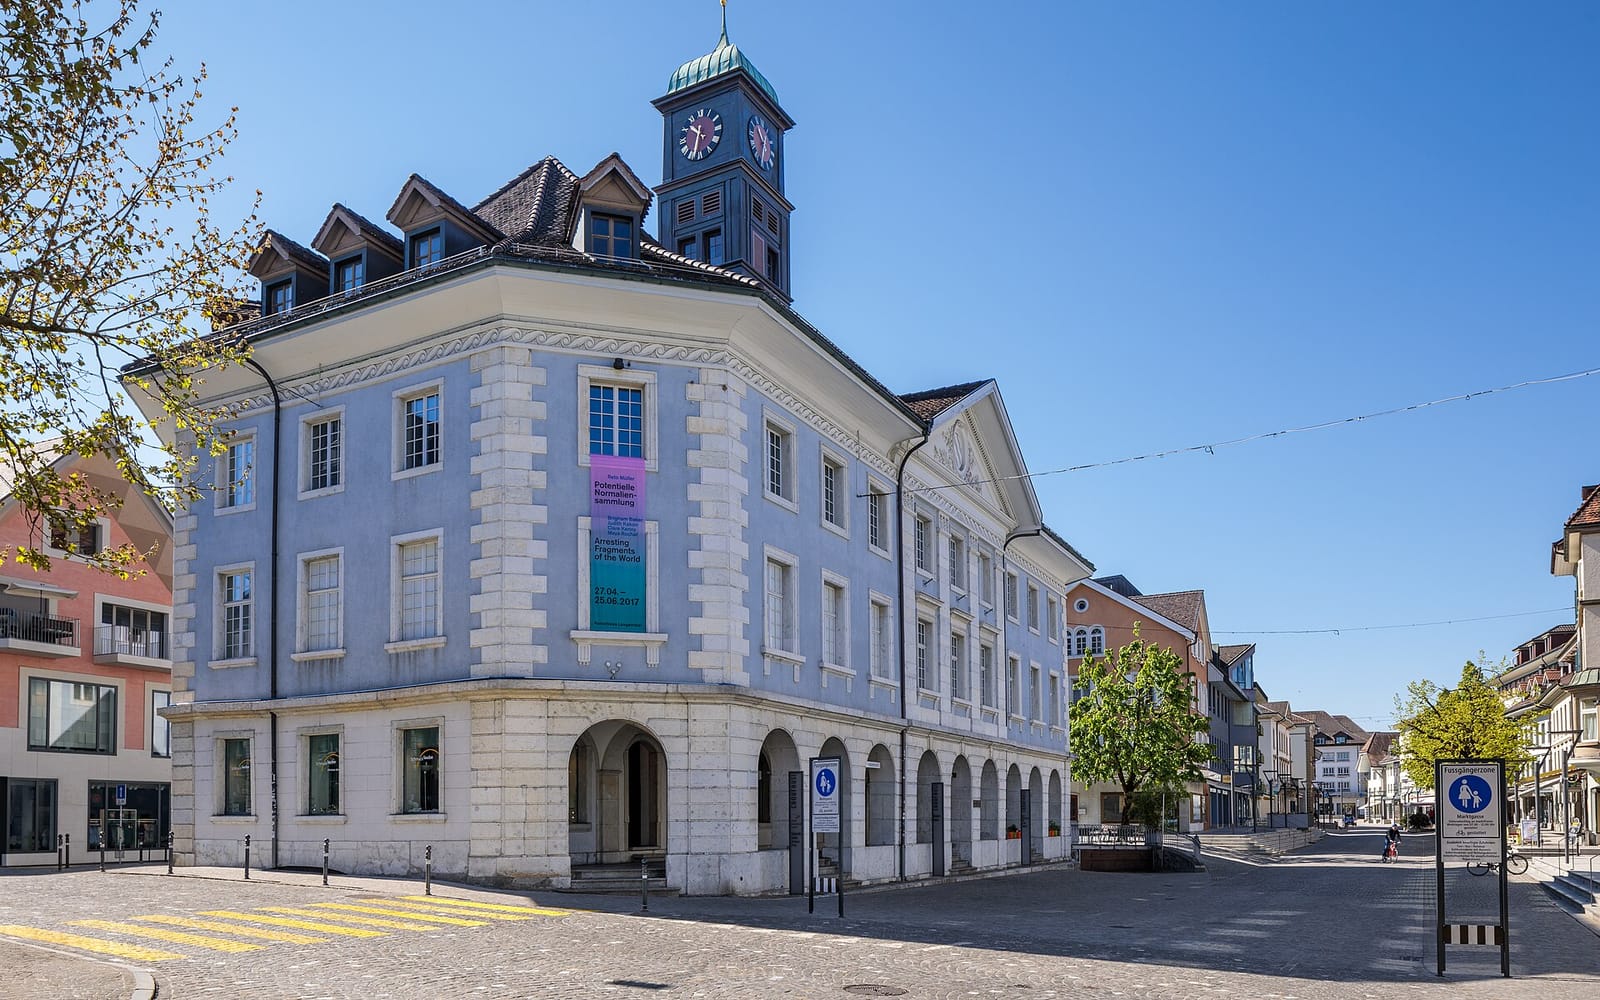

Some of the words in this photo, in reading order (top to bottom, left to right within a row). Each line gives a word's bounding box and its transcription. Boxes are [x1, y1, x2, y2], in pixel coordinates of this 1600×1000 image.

[595, 481, 635, 491] Potentielle
[595, 489, 637, 499] Normalien-
[595, 499, 635, 508] sammlung
[594, 537, 629, 547] Arresting
[594, 545, 636, 555] Fragments
[604, 554, 617, 562] the
[619, 555, 641, 563] World
[1444, 766, 1496, 775] Fussgängerzone
